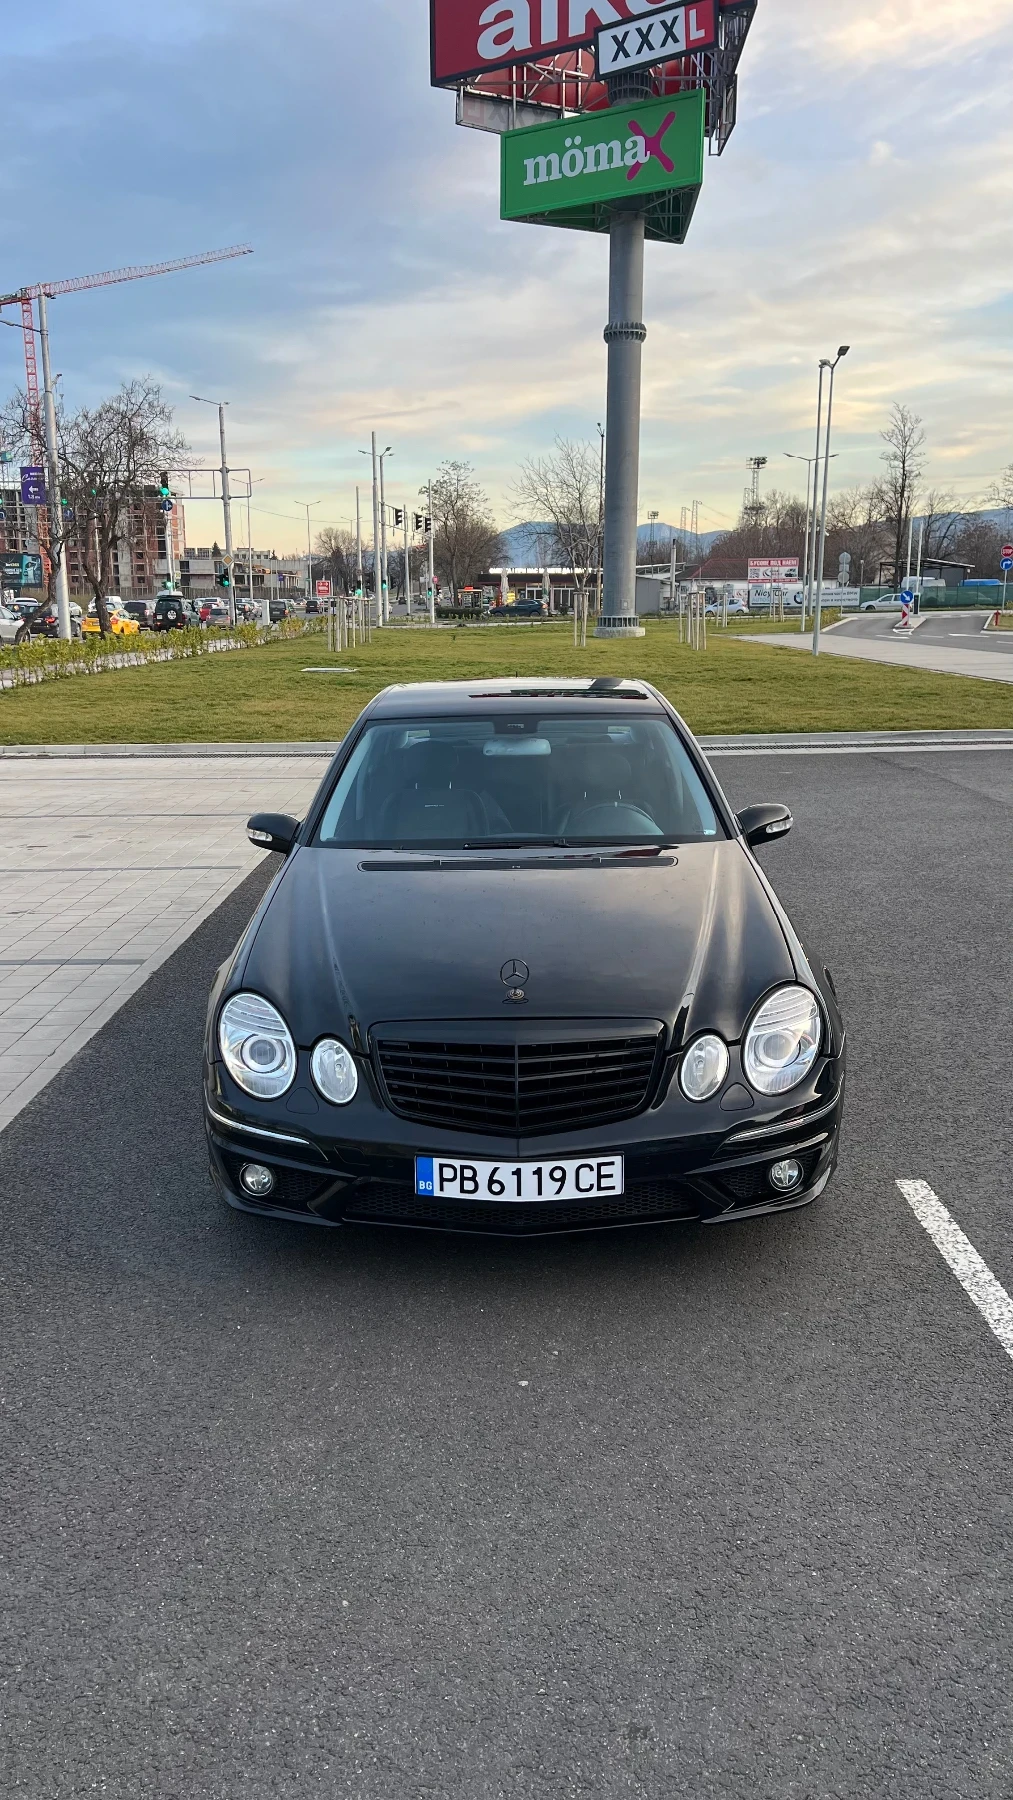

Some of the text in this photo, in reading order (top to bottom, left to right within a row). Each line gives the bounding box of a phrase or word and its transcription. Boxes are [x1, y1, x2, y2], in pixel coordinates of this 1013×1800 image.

[611, 8, 705, 62] XXXL
[419, 1161, 616, 1197] BG PB 6119 CE
